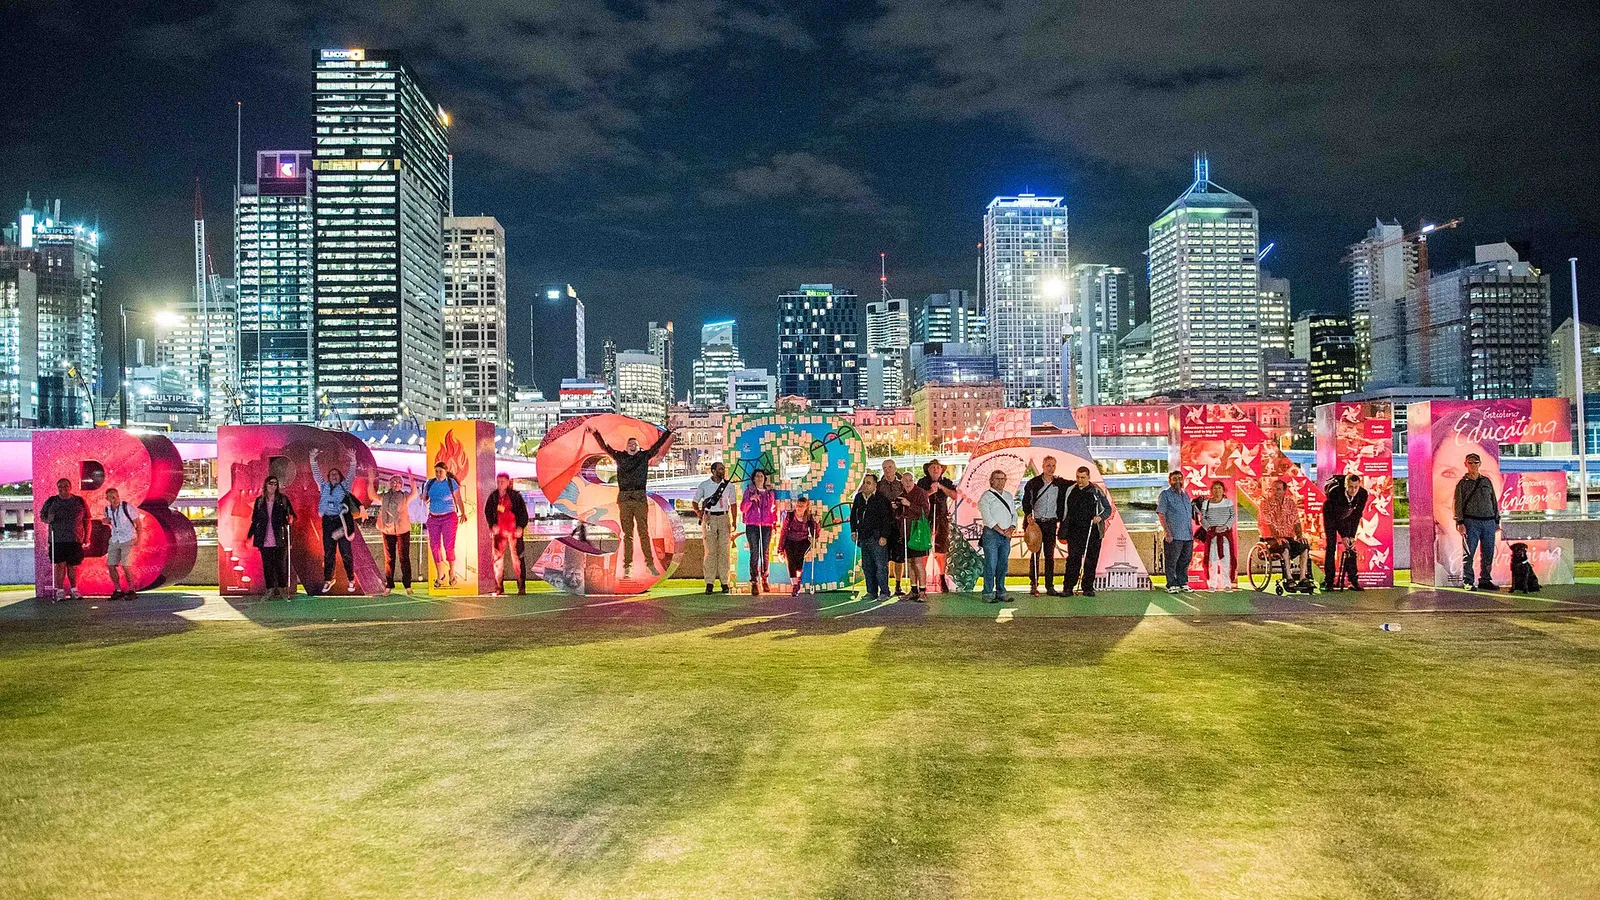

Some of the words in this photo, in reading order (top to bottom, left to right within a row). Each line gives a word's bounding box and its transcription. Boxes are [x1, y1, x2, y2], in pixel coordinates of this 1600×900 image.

[148, 394, 198, 403] MULTIPLEX
[1453, 412, 1557, 446] Educating
[1501, 487, 1562, 512] Engaging
